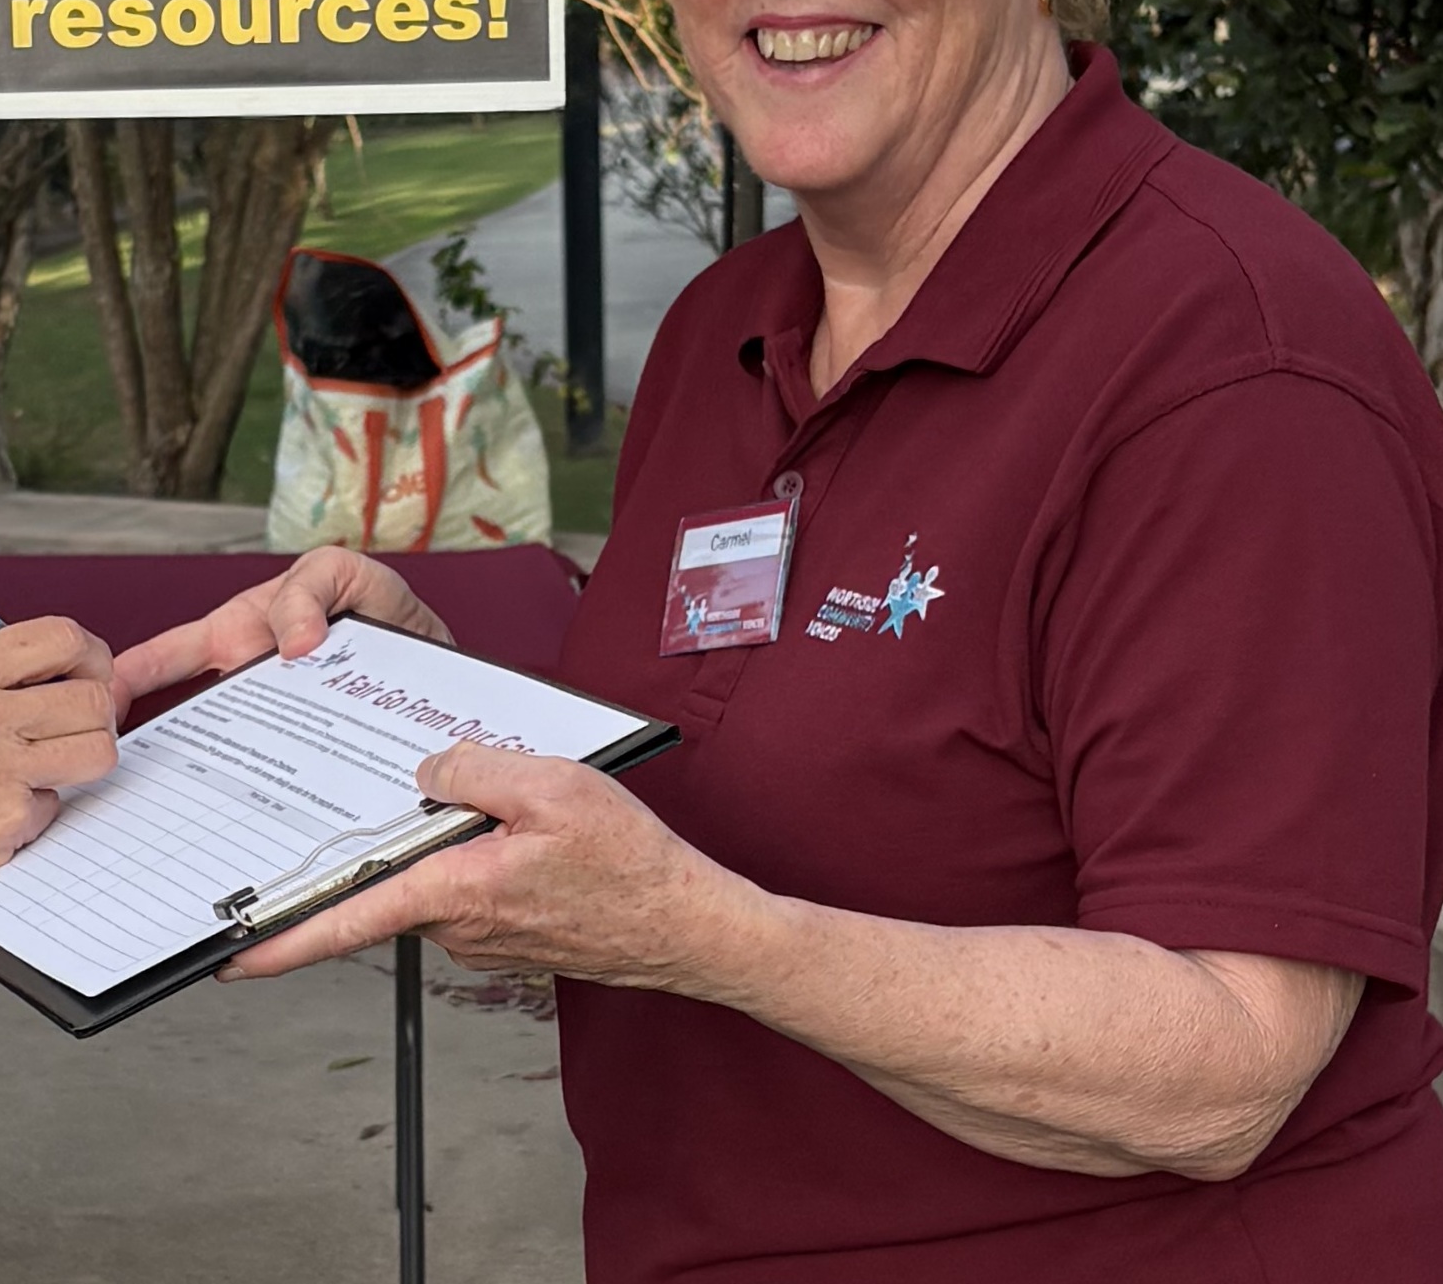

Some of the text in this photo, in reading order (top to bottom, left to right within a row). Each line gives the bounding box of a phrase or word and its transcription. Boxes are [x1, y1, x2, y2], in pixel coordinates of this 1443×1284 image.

[710, 527, 752, 552] Carmel
[321, 670, 354, 688] A
[336, 674, 385, 700] Fair
[372, 689, 409, 710] Go
[395, 698, 457, 731] From
[447, 719, 498, 745] Our
